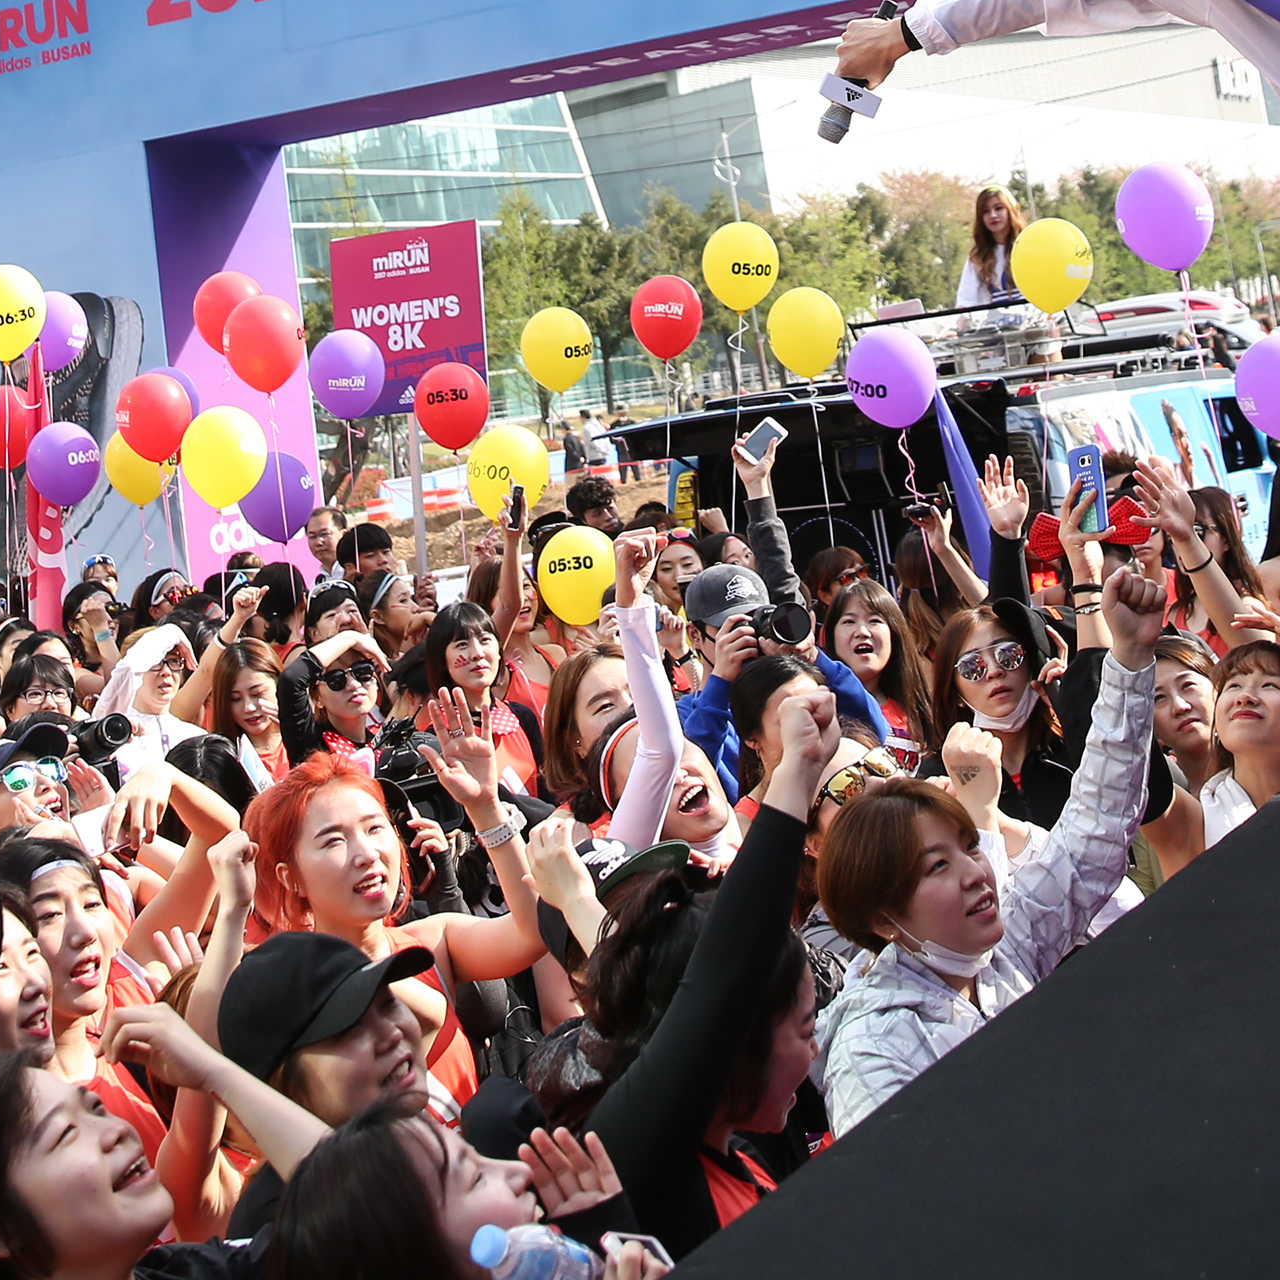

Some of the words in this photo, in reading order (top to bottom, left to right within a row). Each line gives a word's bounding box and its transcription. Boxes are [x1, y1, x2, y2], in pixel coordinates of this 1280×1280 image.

[41, 41, 92, 65] BUSAN
[509, 23, 810, 84] GREATER
[372, 248, 430, 272] miRUN
[731, 262, 771, 276] 05:00
[351, 295, 461, 329] WOMEN'S
[644, 303, 684, 316] miRUN
[387, 321, 426, 352] 8K
[426, 389, 468, 405] 05:30
[848, 377, 887, 398] 07:00
[68, 449, 100, 465] 06:00
[468, 463, 510, 480] 06:00
[548, 556, 594, 574] 05:30
